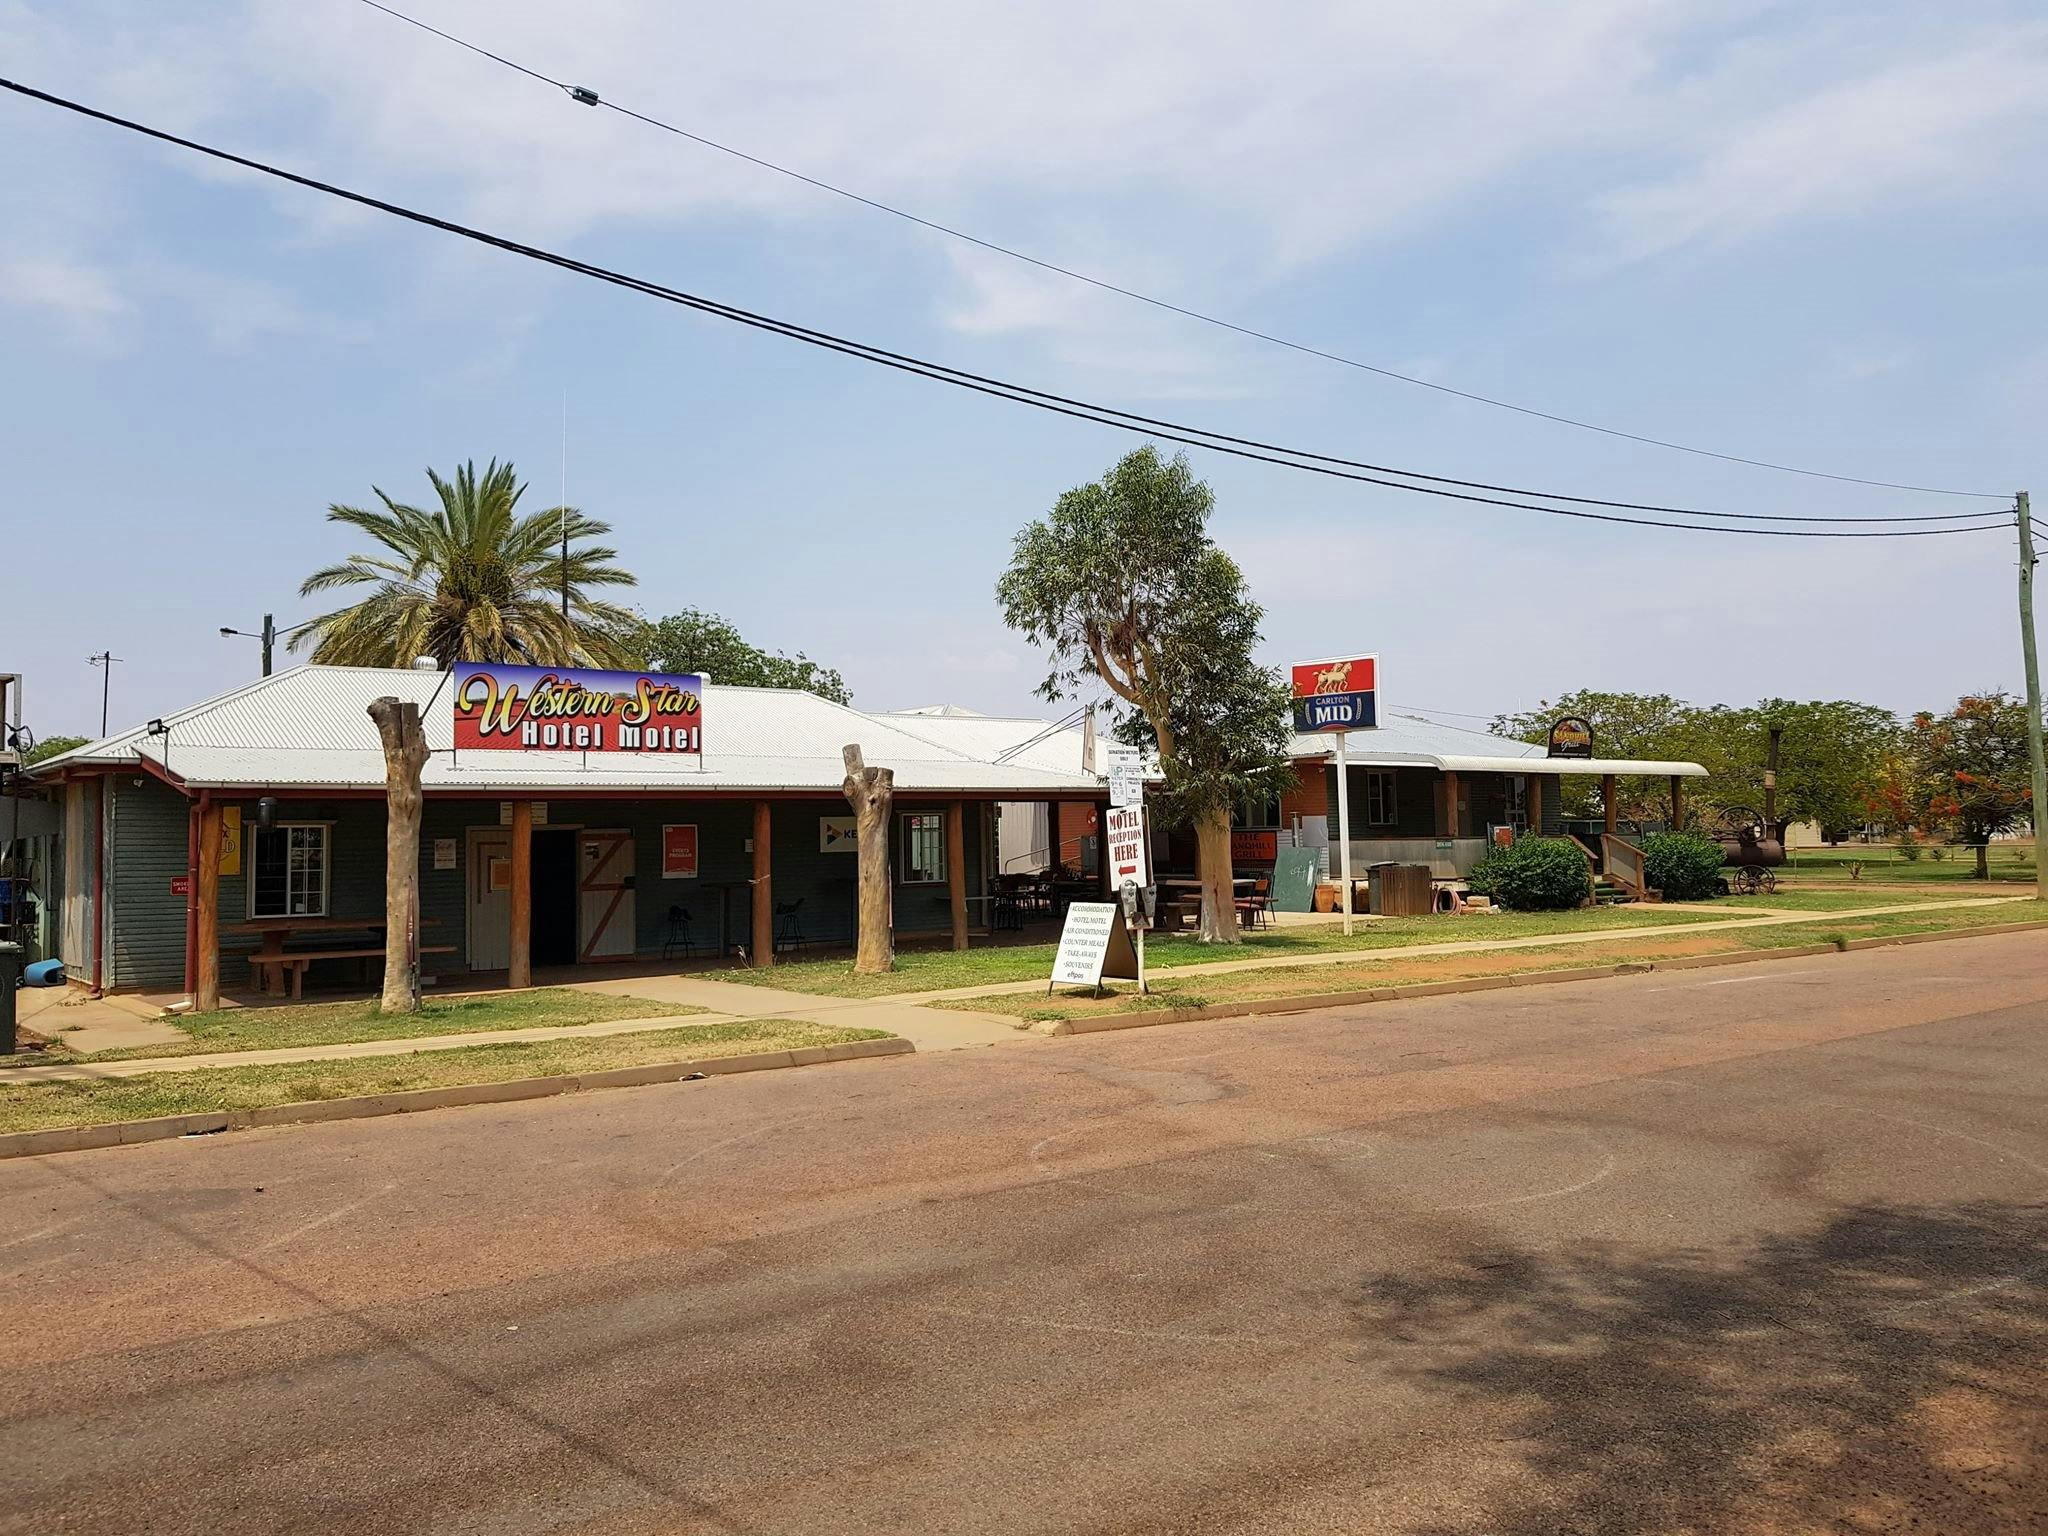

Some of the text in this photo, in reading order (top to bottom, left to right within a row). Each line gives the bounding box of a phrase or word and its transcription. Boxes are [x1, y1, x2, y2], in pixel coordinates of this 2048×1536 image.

[458, 671, 701, 737] Western Star
[1315, 695, 1350, 706] CARLTON
[1315, 704, 1353, 725] MID
[1109, 811, 1140, 831] MOTEL
[844, 829, 858, 839] KE
[1108, 829, 1142, 844] RECEPTION
[1114, 843, 1139, 862] HERE
[1233, 842, 1272, 850] ANDHILL
